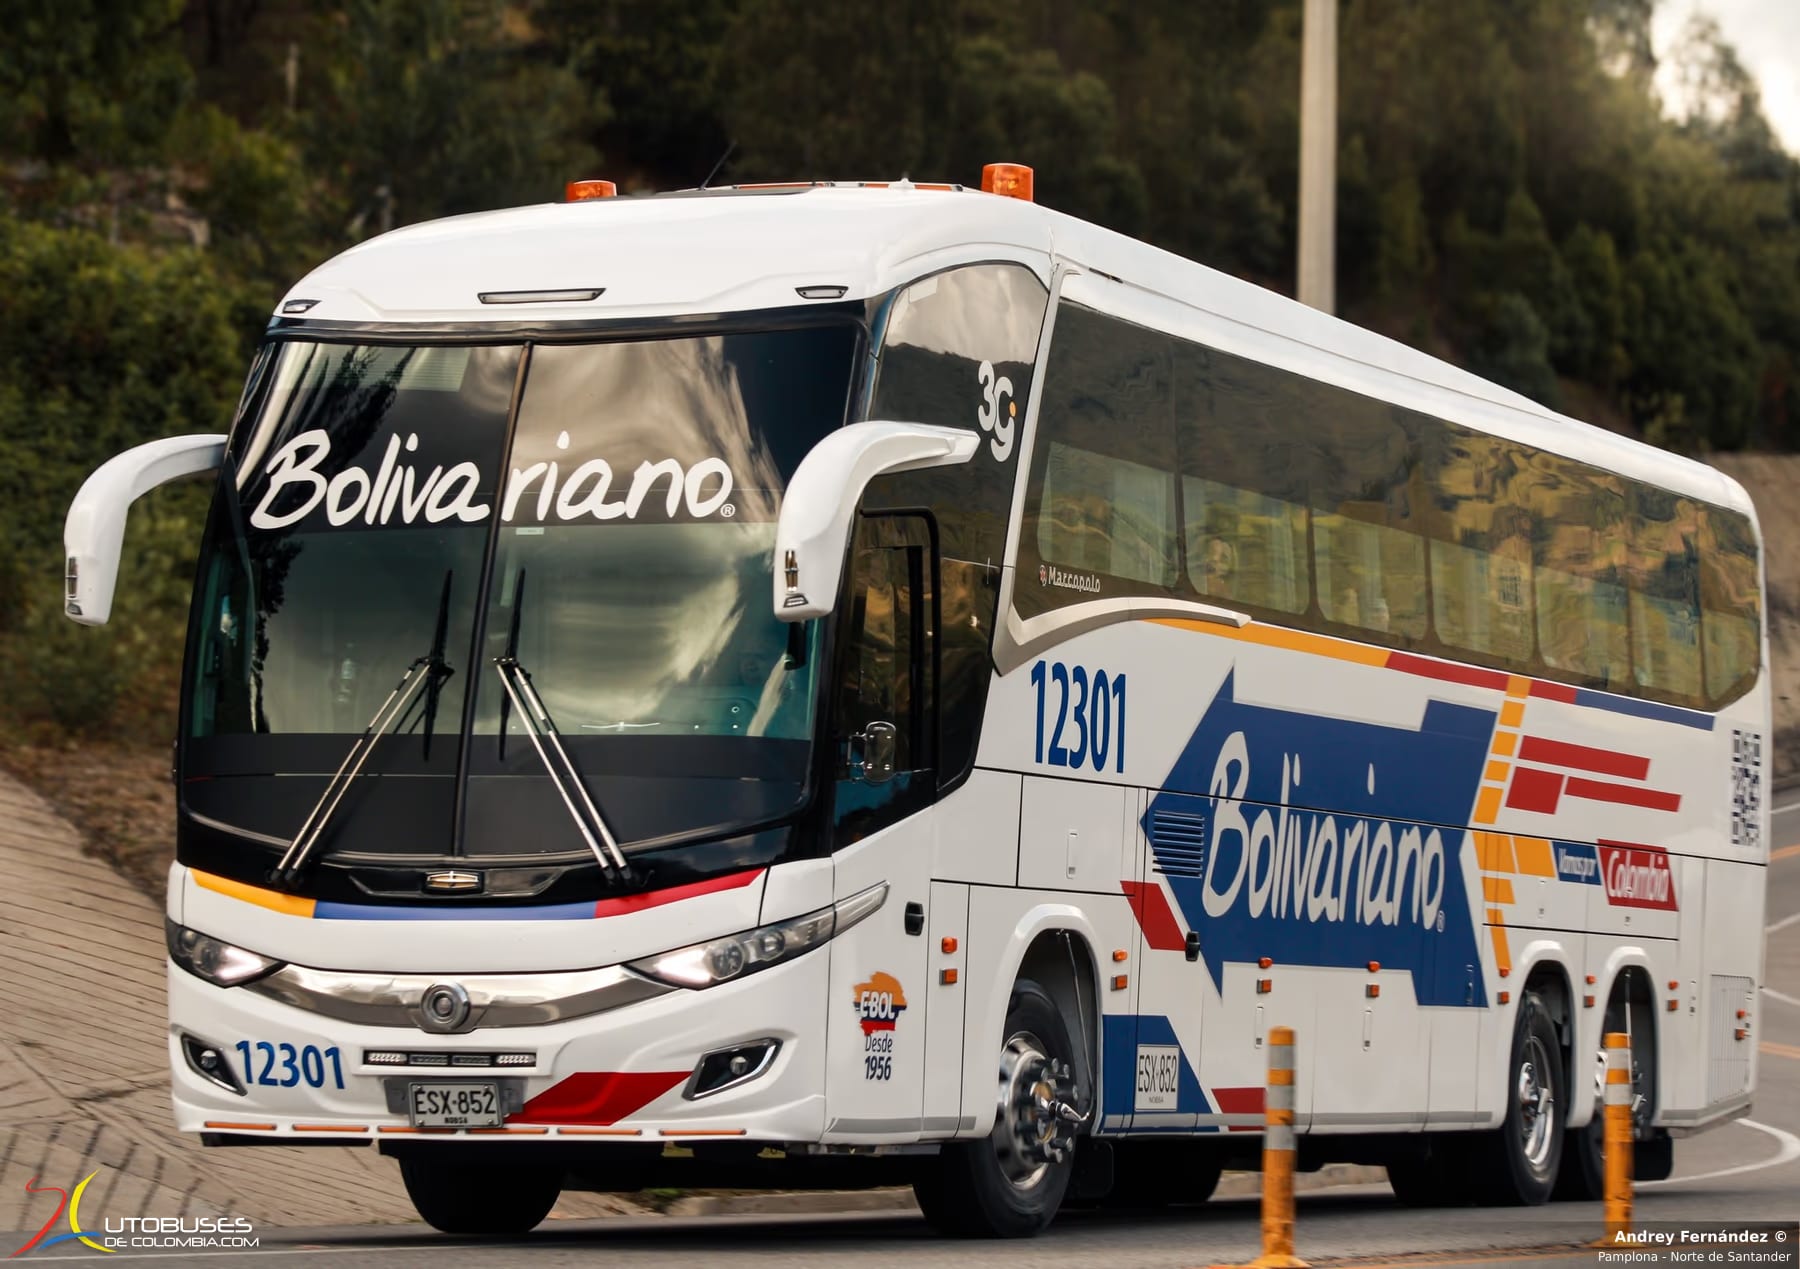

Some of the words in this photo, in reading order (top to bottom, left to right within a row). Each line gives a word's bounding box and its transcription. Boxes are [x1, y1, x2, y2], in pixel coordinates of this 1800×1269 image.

[1048, 566, 1100, 593] Marcopolo
[1031, 660, 1126, 774] 12301
[1202, 731, 1445, 931] Bolivariano
[1607, 850, 1670, 902] Colombia
[236, 1040, 345, 1090] 12301
[865, 1032, 893, 1053] Desde
[865, 1055, 892, 1081] 1956
